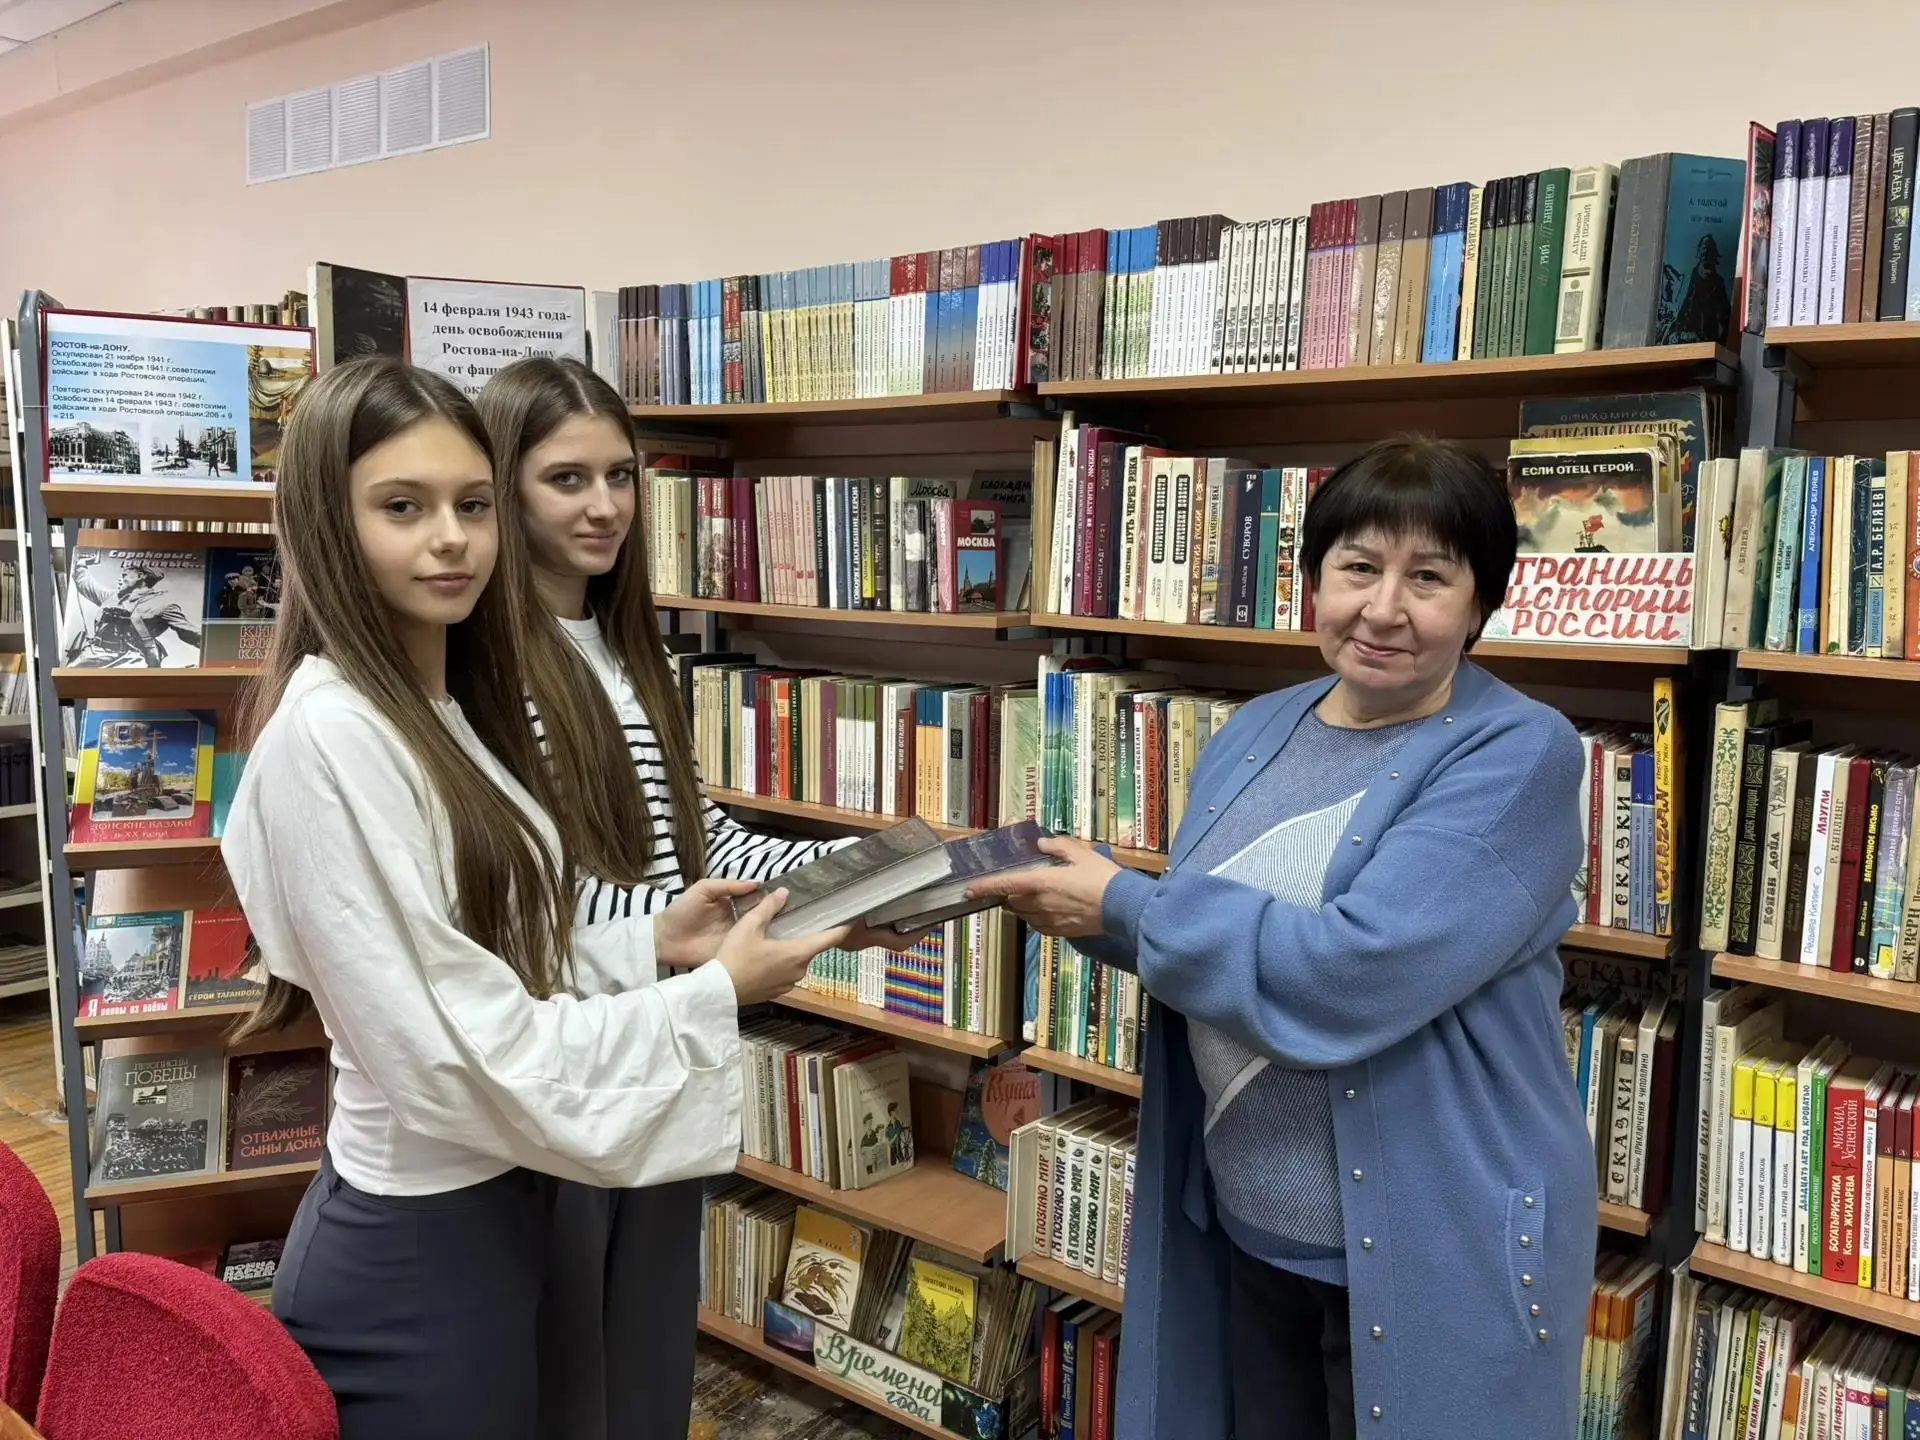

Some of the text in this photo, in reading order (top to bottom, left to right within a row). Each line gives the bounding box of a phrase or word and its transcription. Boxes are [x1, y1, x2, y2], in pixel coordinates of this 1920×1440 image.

[1467, 193, 1480, 262] АРХИПЕЛАГ ГУЛАГ
[1890, 147, 1905, 284] ЦВЕТАЕВА Мой Пушкин
[423, 302, 572, 321] 14 февраля 1943 года-
[432, 325, 563, 340] день освобождения
[51, 340, 131, 352] РОСТОВ-на-ДОНУ.
[52, 349, 103, 360] Оккупирован
[105, 352, 114, 360] 21
[116, 354, 145, 363] ноября
[147, 355, 164, 363] 1941
[52, 358, 102, 369] Освобожден
[104, 361, 114, 369] 29
[116, 362, 144, 371] ноября
[146, 363, 164, 371] 1941
[442, 342, 556, 359] Ростова-на-Дону
[52, 367, 89, 377] войсками
[100, 372, 118, 380] ходе
[121, 371, 166, 382] Ростовской
[52, 385, 90, 396] Повторно
[92, 388, 142, 398] оккупирован
[144, 390, 154, 398] 24
[156, 392, 176, 400] июля
[178, 392, 197, 401] 1942
[448, 366, 464, 375] от
[52, 394, 103, 404] Освобожден
[116, 397, 152, 407] февраля
[154, 399, 173, 408] 1943
[182, 401, 227, 410] советскими
[52, 403, 90, 412] войсками
[98, 406, 117, 415] ходе
[119, 406, 164, 416] Ростовской
[59, 412, 75, 420] 215
[1522, 466, 1555, 477] ЕСЛИ
[1556, 464, 1590, 476] ОТЕЦ
[1126, 485, 1137, 544] ПУТЬ ЧЕРЕЗ
[1808, 504, 1818, 552] АЛЕКСАНДР
[1872, 492, 1884, 542] БЕЛЯЕВ
[957, 536, 996, 548] МОСКВА
[1243, 515, 1252, 560] СУВОРОВ
[1511, 609, 1680, 642] РОССИИ
[1745, 788, 1758, 843] ДЖЕК ЛОНДОН
[1816, 790, 1831, 834] МАУГЛИ
[1832, 799, 1844, 853] КИПЛИНГ
[1615, 796, 1631, 906] СКАЗКИ
[1864, 804, 1878, 883] ЗАГАДОЧНОЕ ПИСЬМО
[1763, 831, 1781, 926] КОНАН ДОЙЛ
[88, 998, 98, 1017] Я
[188, 989, 262, 1001] ГЕРОИ ТАГАНРОГА
[124, 1064, 197, 1087] ПОБЕДЫ
[1703, 1024, 1714, 1085] ЗАДАЧНИК
[1635, 1053, 1649, 1156] ПРИКЛЮЧЕНИЯ ЧИПОЛЛИНО
[240, 1137, 322, 1158] СЫНЫ ДОНА
[241, 1126, 320, 1144] ОТВАЖНЫЕ
[1611, 1078, 1632, 1185] СКАЗКИ
[1700, 1109, 1709, 1146] ОСТЕР
[1799, 1085, 1811, 1212] ДВАДЦАТЬ ЛЕТ ПОД КРОВАТЬЮ
[1832, 1105, 1845, 1151] МИХАИЛ
[1842, 1099, 1858, 1161] Успенский
[1071, 1163, 1084, 1193] МИР
[1034, 1155, 1050, 1249] Я ПОЗНАЮ МИР
[1051, 1156, 1066, 1253] Я ПОЗНАЮ МИР
[1069, 1195, 1082, 1247] ПОЗНАЮ
[1084, 1170, 1101, 1268] Я ПОЗНАЮ МИР
[1125, 1189, 1134, 1213] МИР
[1829, 1174, 1842, 1252] БОГАТЫРИСТИКА
[1843, 1174, 1856, 1256] Кости ЖИХАРЕВА
[1862, 1160, 1873, 1250] КОРОЛЕВСТВО КРИВЫХ ЗЕРКАЛ
[1120, 1213, 1132, 1267] ПОЗНАЮ
[815, 1331, 943, 1407] Времена
[1748, 1398, 1760, 1429] СКАЗКИ
[1754, 1338, 1768, 1388] КАРТИНКАХ
[884, 1389, 936, 1423] года
[1816, 1384, 1828, 1406] ПУХ
[1833, 1383, 1845, 1434] АНФИСУ
